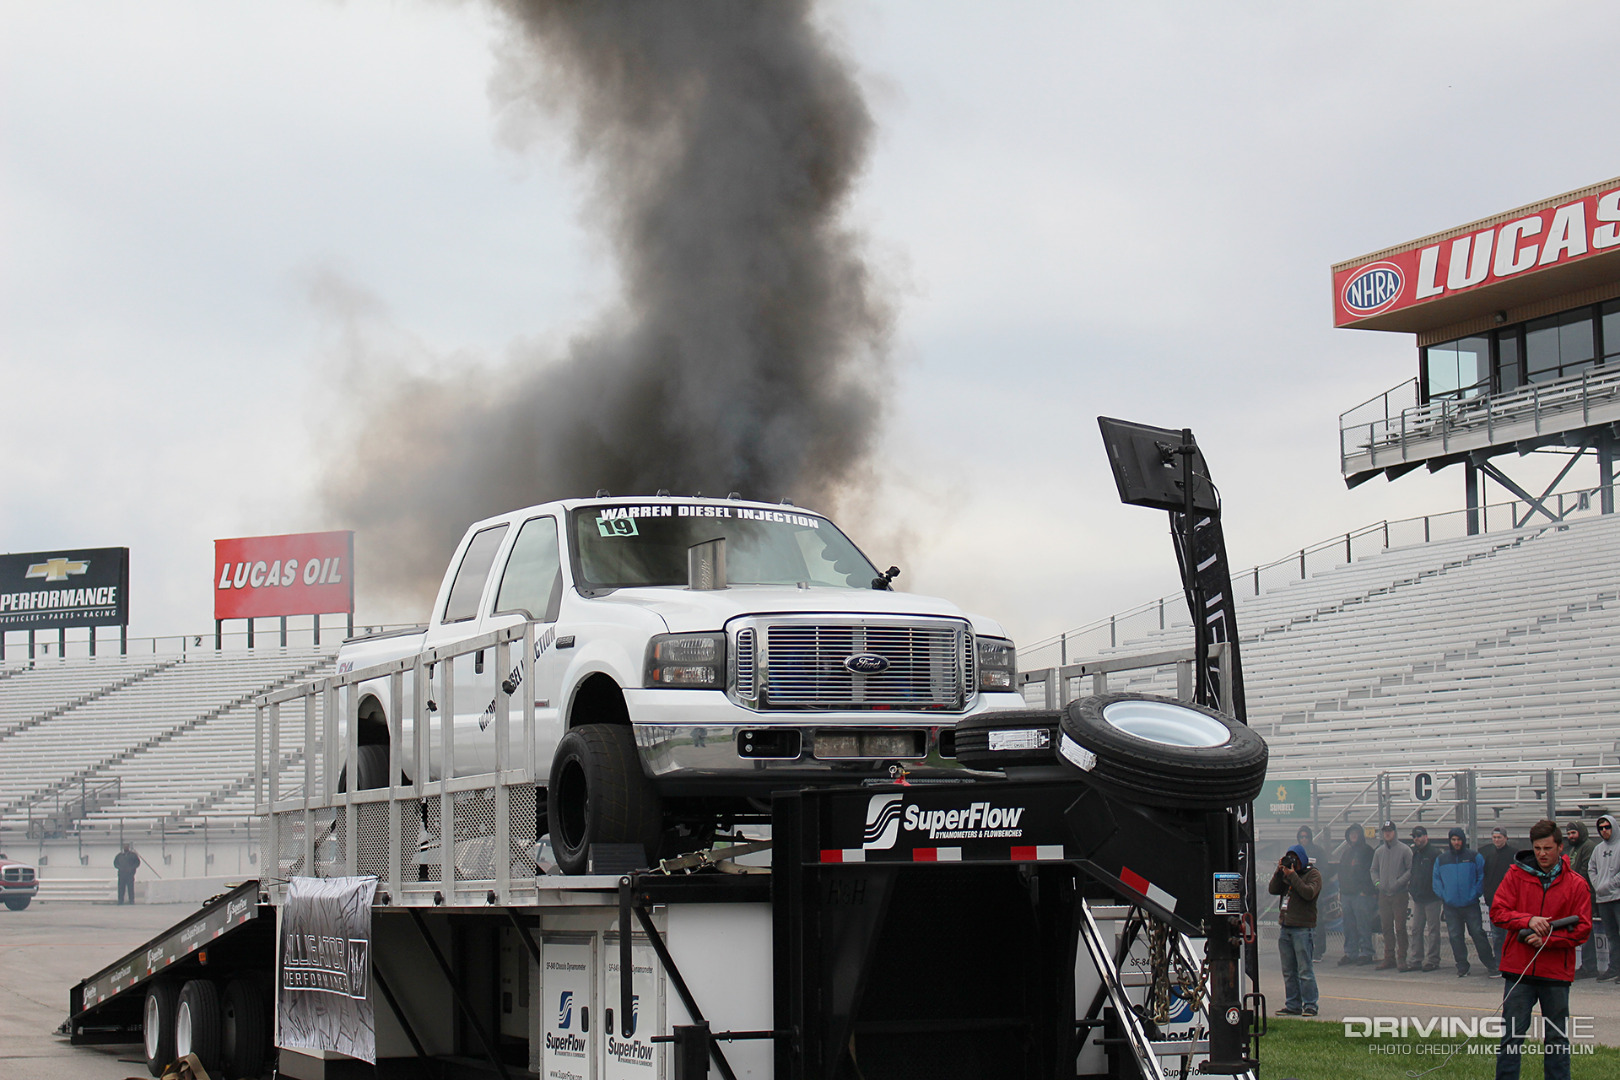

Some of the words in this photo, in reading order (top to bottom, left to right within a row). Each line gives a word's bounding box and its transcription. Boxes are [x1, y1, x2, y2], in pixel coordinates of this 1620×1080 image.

[1350, 271, 1397, 308] NHRA
[1578, 493, 1591, 511] A
[598, 517, 635, 536] 19
[600, 505, 672, 521] WARREN
[677, 505, 732, 519] DIESEL
[737, 507, 820, 529] INJECTION
[218, 558, 299, 590] LUCAS
[303, 556, 343, 586] OIL
[0, 586, 117, 611] PERFORMANCE
[0, 614, 40, 623] VEHICLES
[49, 612, 74, 620] PARTS
[83, 609, 117, 618] RACING
[193, 636, 203, 648] 2
[856, 657, 881, 669] Ford
[1415, 772, 1432, 802] C
[903, 802, 1022, 840] SuperFlow
[935, 830, 978, 839] DYNAMOMETERS
[978, 830, 983, 838] &
[983, 829, 1023, 838] FLOWBENCHES
[284, 933, 347, 971] ALLIGATOR
[284, 971, 349, 991] PERFORMANCE
[546, 1032, 586, 1055] SuperFlow
[608, 1036, 653, 1062] SuperFlow
